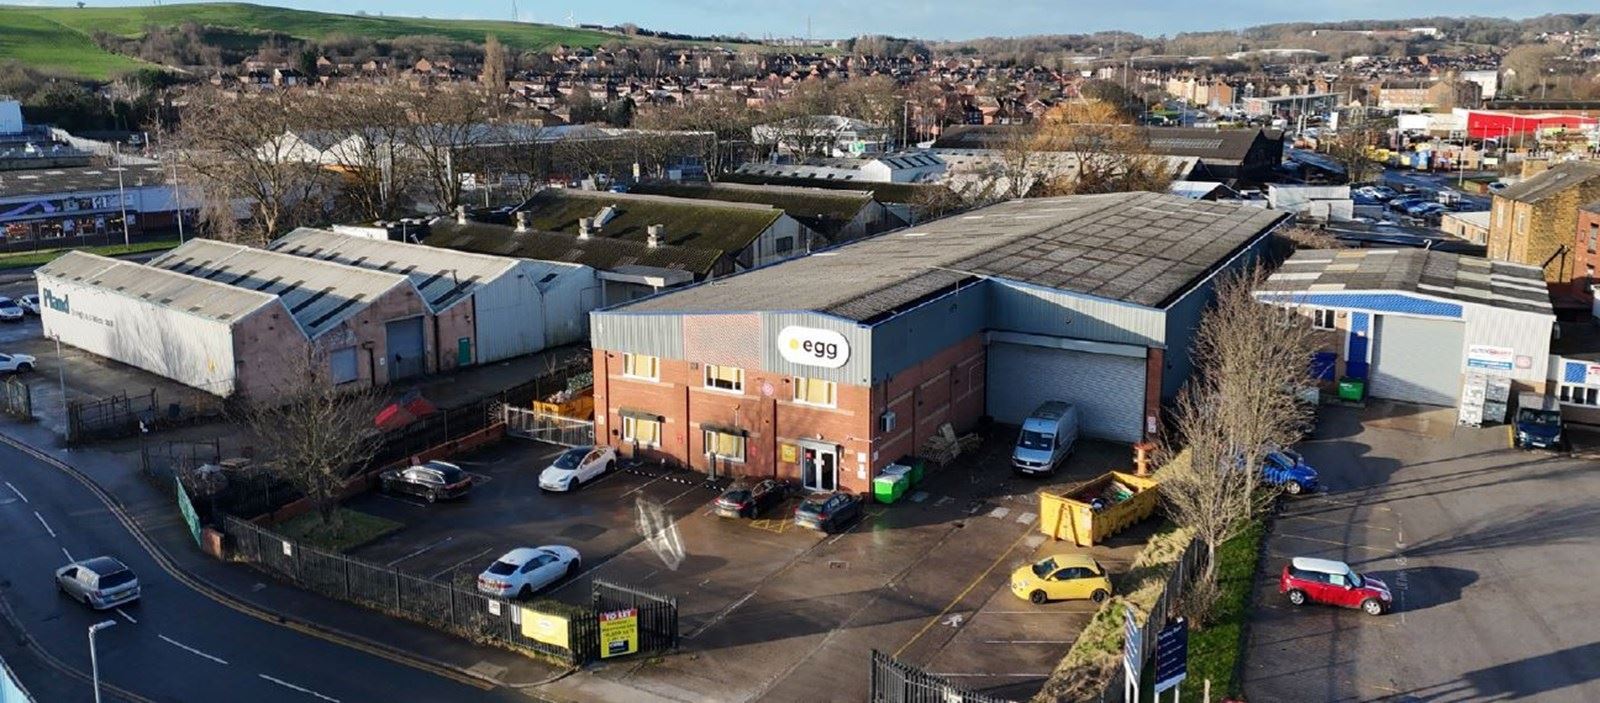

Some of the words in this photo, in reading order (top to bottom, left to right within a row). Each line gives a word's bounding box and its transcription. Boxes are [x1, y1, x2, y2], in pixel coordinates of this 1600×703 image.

[803, 340, 837, 359] egg
[605, 612, 617, 620] TO
[618, 609, 631, 618] LET
